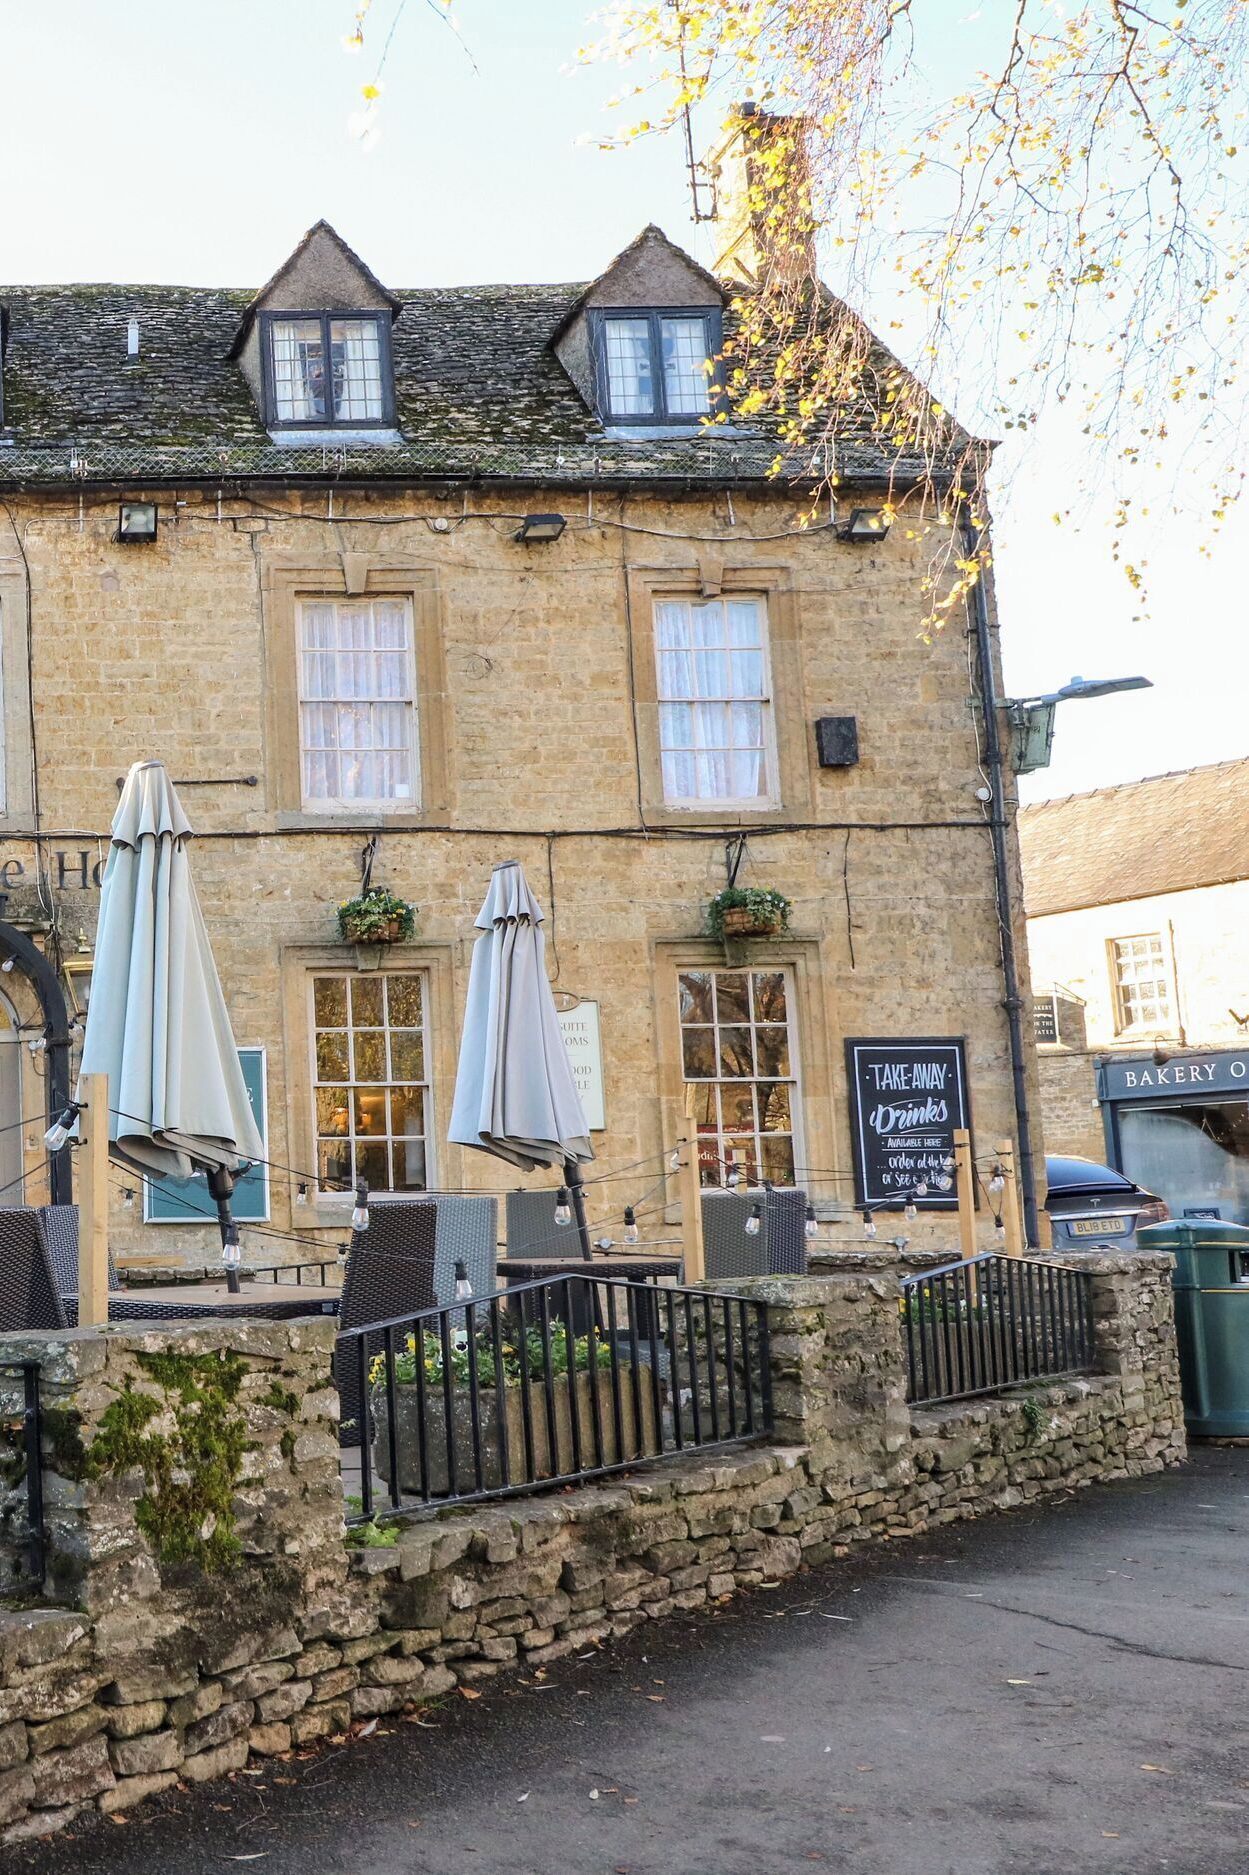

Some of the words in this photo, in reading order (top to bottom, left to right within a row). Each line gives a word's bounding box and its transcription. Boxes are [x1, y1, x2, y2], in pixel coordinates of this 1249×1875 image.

[868, 1062, 948, 1091] TAKE-AWAY
[1124, 1063, 1216, 1088] BAKERY
[869, 1096, 949, 1136] Drinks
[923, 1137, 942, 1148] HERE
